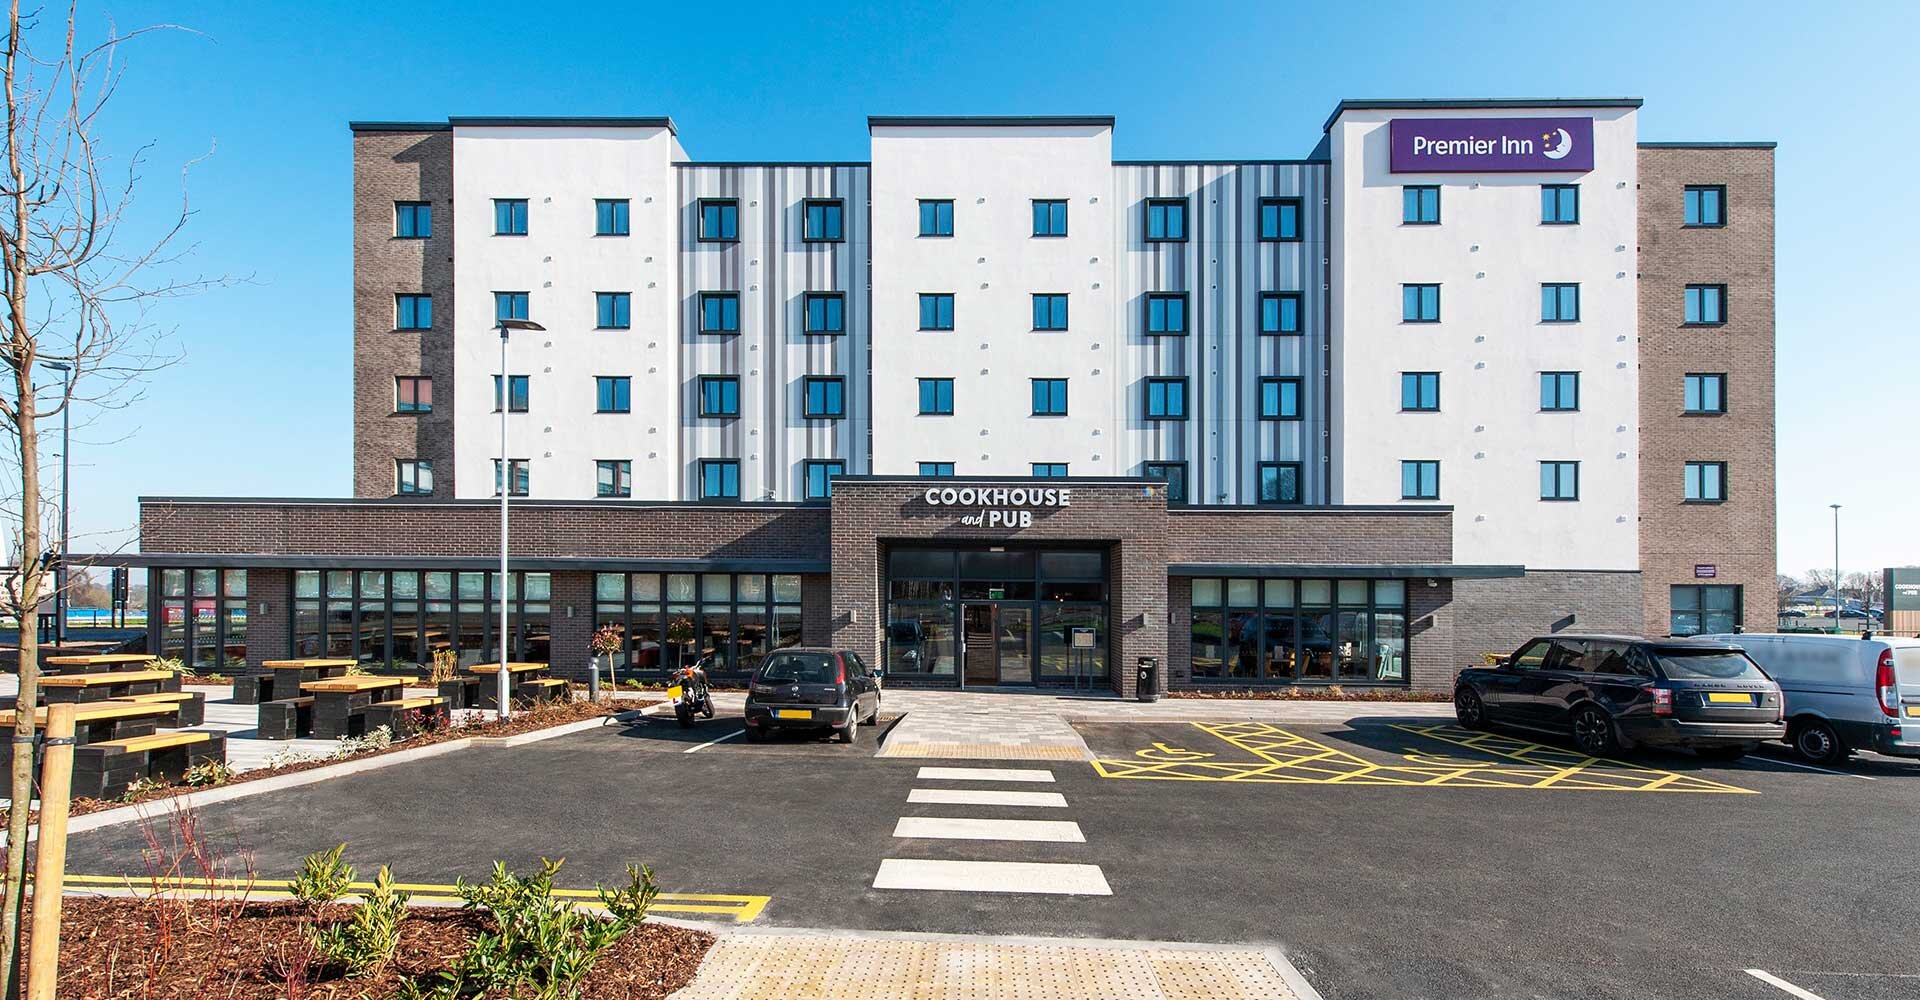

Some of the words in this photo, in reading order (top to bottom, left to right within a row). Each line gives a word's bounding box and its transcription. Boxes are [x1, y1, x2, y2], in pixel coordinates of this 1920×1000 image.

[1413, 136, 1497, 155] Premier
[1502, 135, 1533, 155] Inn
[925, 487, 1073, 506] COOKHOUSE
[960, 509, 985, 528] and
[989, 510, 1033, 528] PUB
